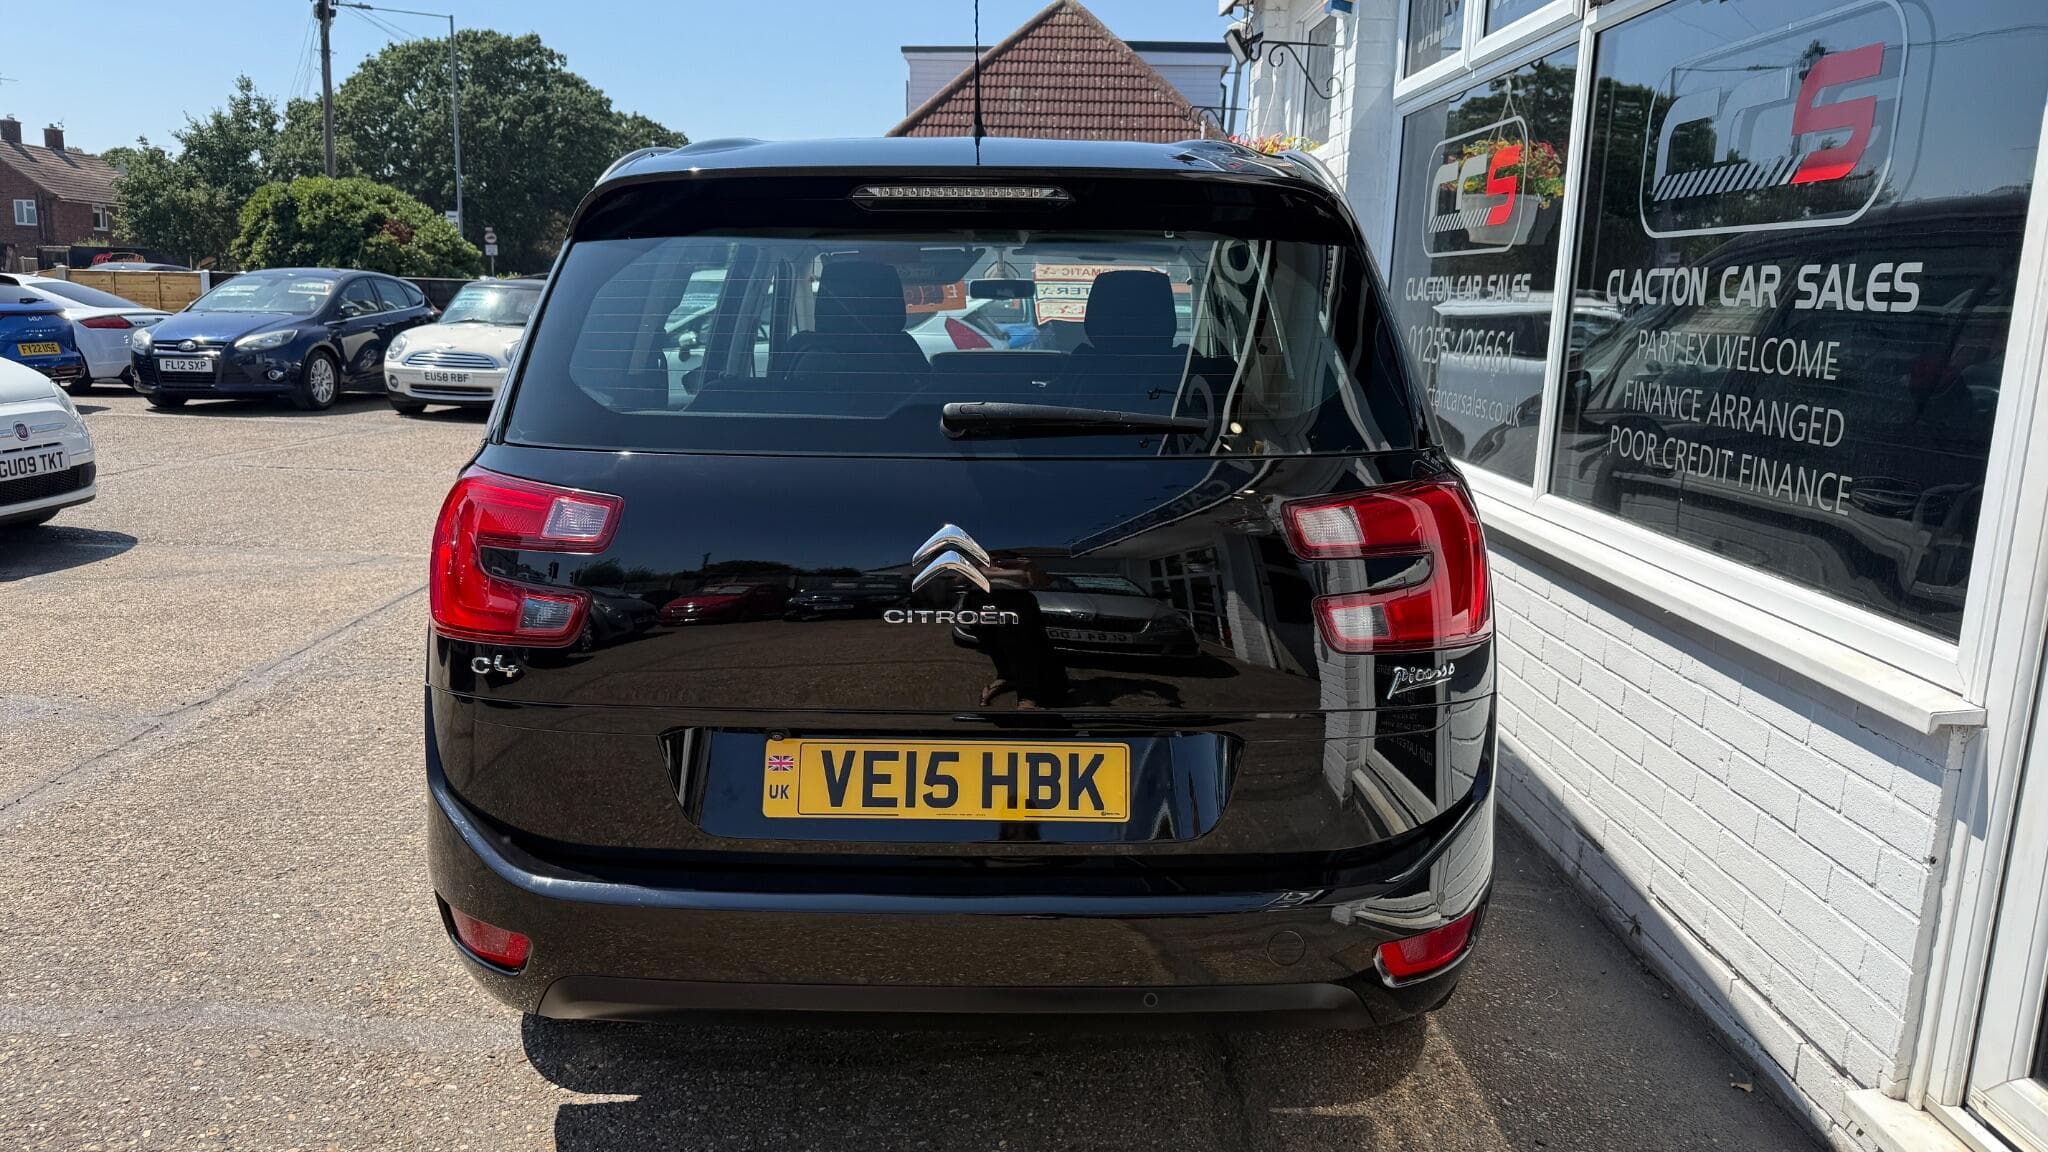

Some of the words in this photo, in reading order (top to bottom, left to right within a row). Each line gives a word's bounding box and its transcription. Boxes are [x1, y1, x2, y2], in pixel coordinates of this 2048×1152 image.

[1405, 276, 1454, 301] CLACTON
[1457, 275, 1482, 300] CAR
[1487, 273, 1532, 303] SALES
[1605, 267, 1709, 306] CLACTON
[1719, 265, 1781, 308] CAR
[1795, 262, 1924, 313] SALES
[21, 343, 42, 354] FY22
[1637, 329, 1682, 363] PART
[1684, 333, 1711, 367] EX
[1716, 335, 1841, 381] WELCOME
[165, 360, 185, 370] FL12
[187, 360, 207, 370] SXP
[450, 373, 470, 383] RBF
[1624, 380, 1704, 422] FINANCE
[1706, 392, 1845, 447] ARRANGED
[0, 456, 37, 478] GU09
[39, 451, 64, 471] TKT
[1608, 425, 1658, 466] POOR
[1662, 437, 1734, 484] CREDIT
[1737, 453, 1853, 516] FINANCE
[471, 654, 519, 678] C4
[1387, 662, 1456, 700] Picasso
[769, 784, 789, 799] UK
[821, 750, 960, 809] VE15
[981, 751, 1106, 811] HBK
